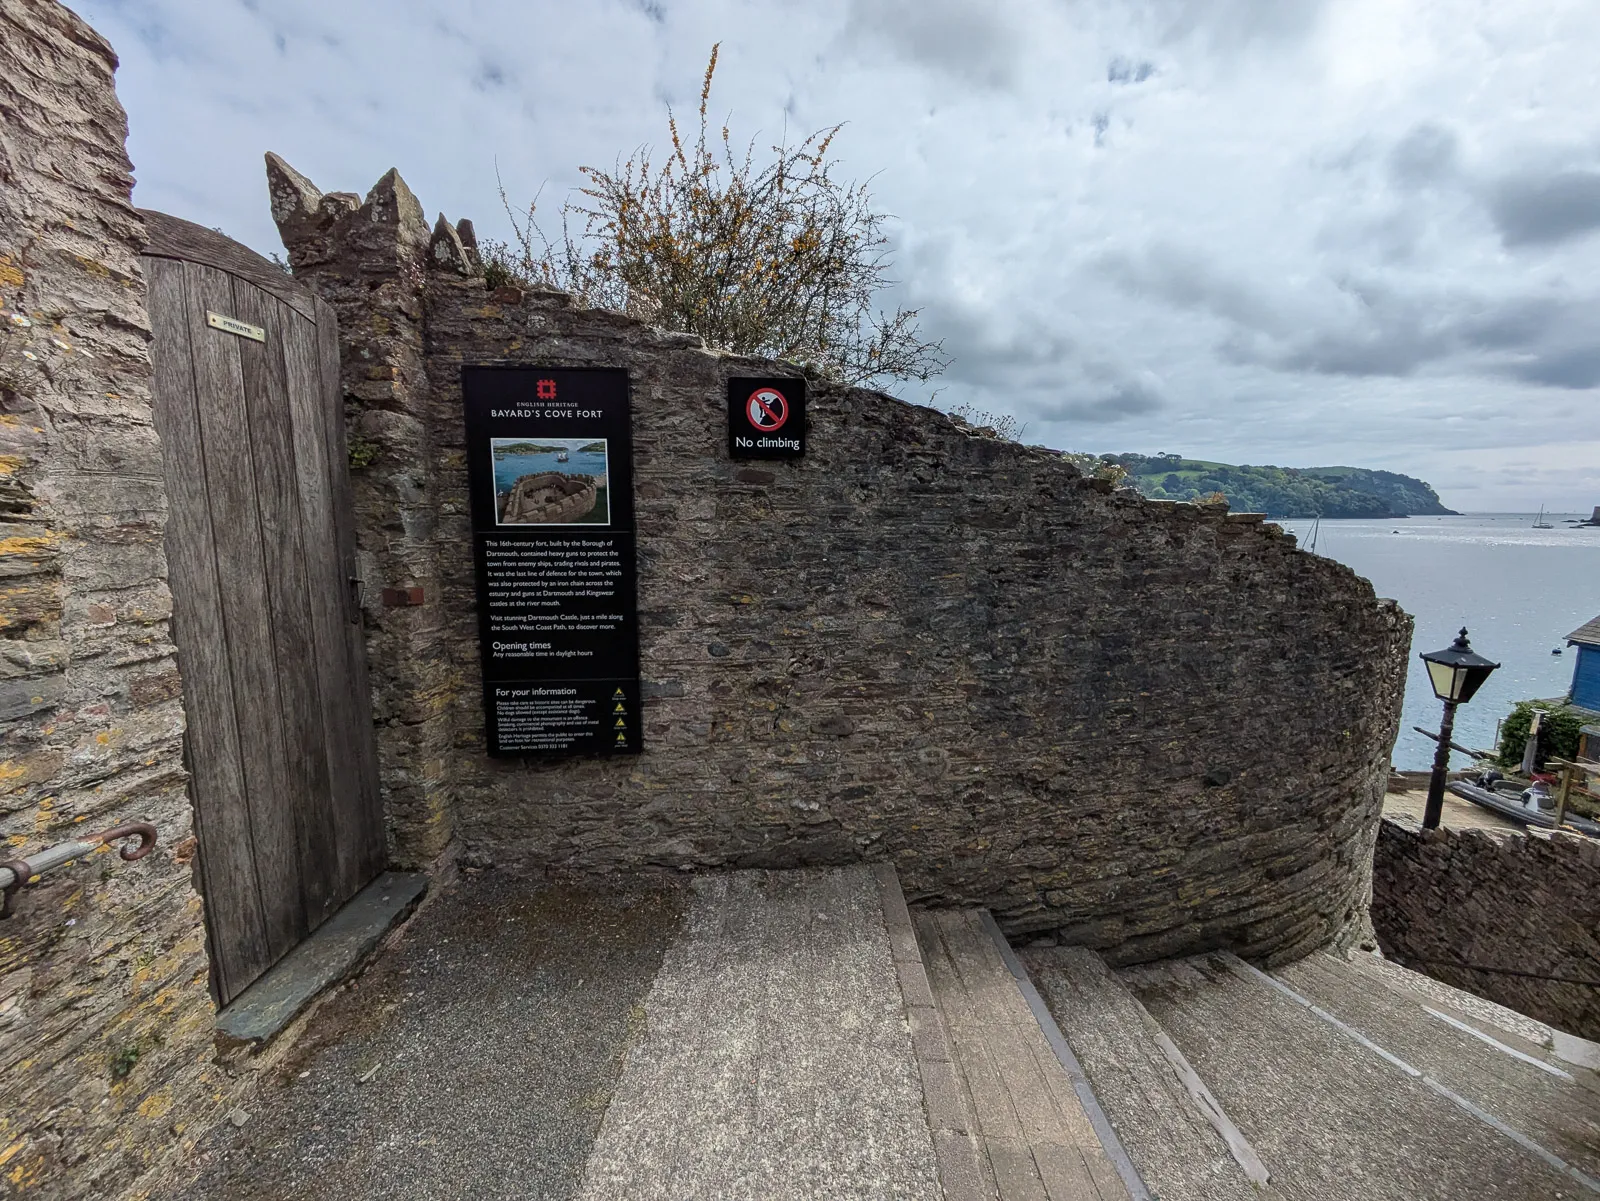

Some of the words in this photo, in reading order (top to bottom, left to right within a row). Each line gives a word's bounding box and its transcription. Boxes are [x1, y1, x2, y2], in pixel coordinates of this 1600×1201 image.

[223, 320, 252, 333] PRIVATE
[491, 409, 540, 418] BAYARD'S
[736, 437, 753, 447] No
[757, 437, 800, 450] climbing
[492, 641, 528, 651] Opening
[529, 641, 552, 649] times
[511, 689, 530, 698] your
